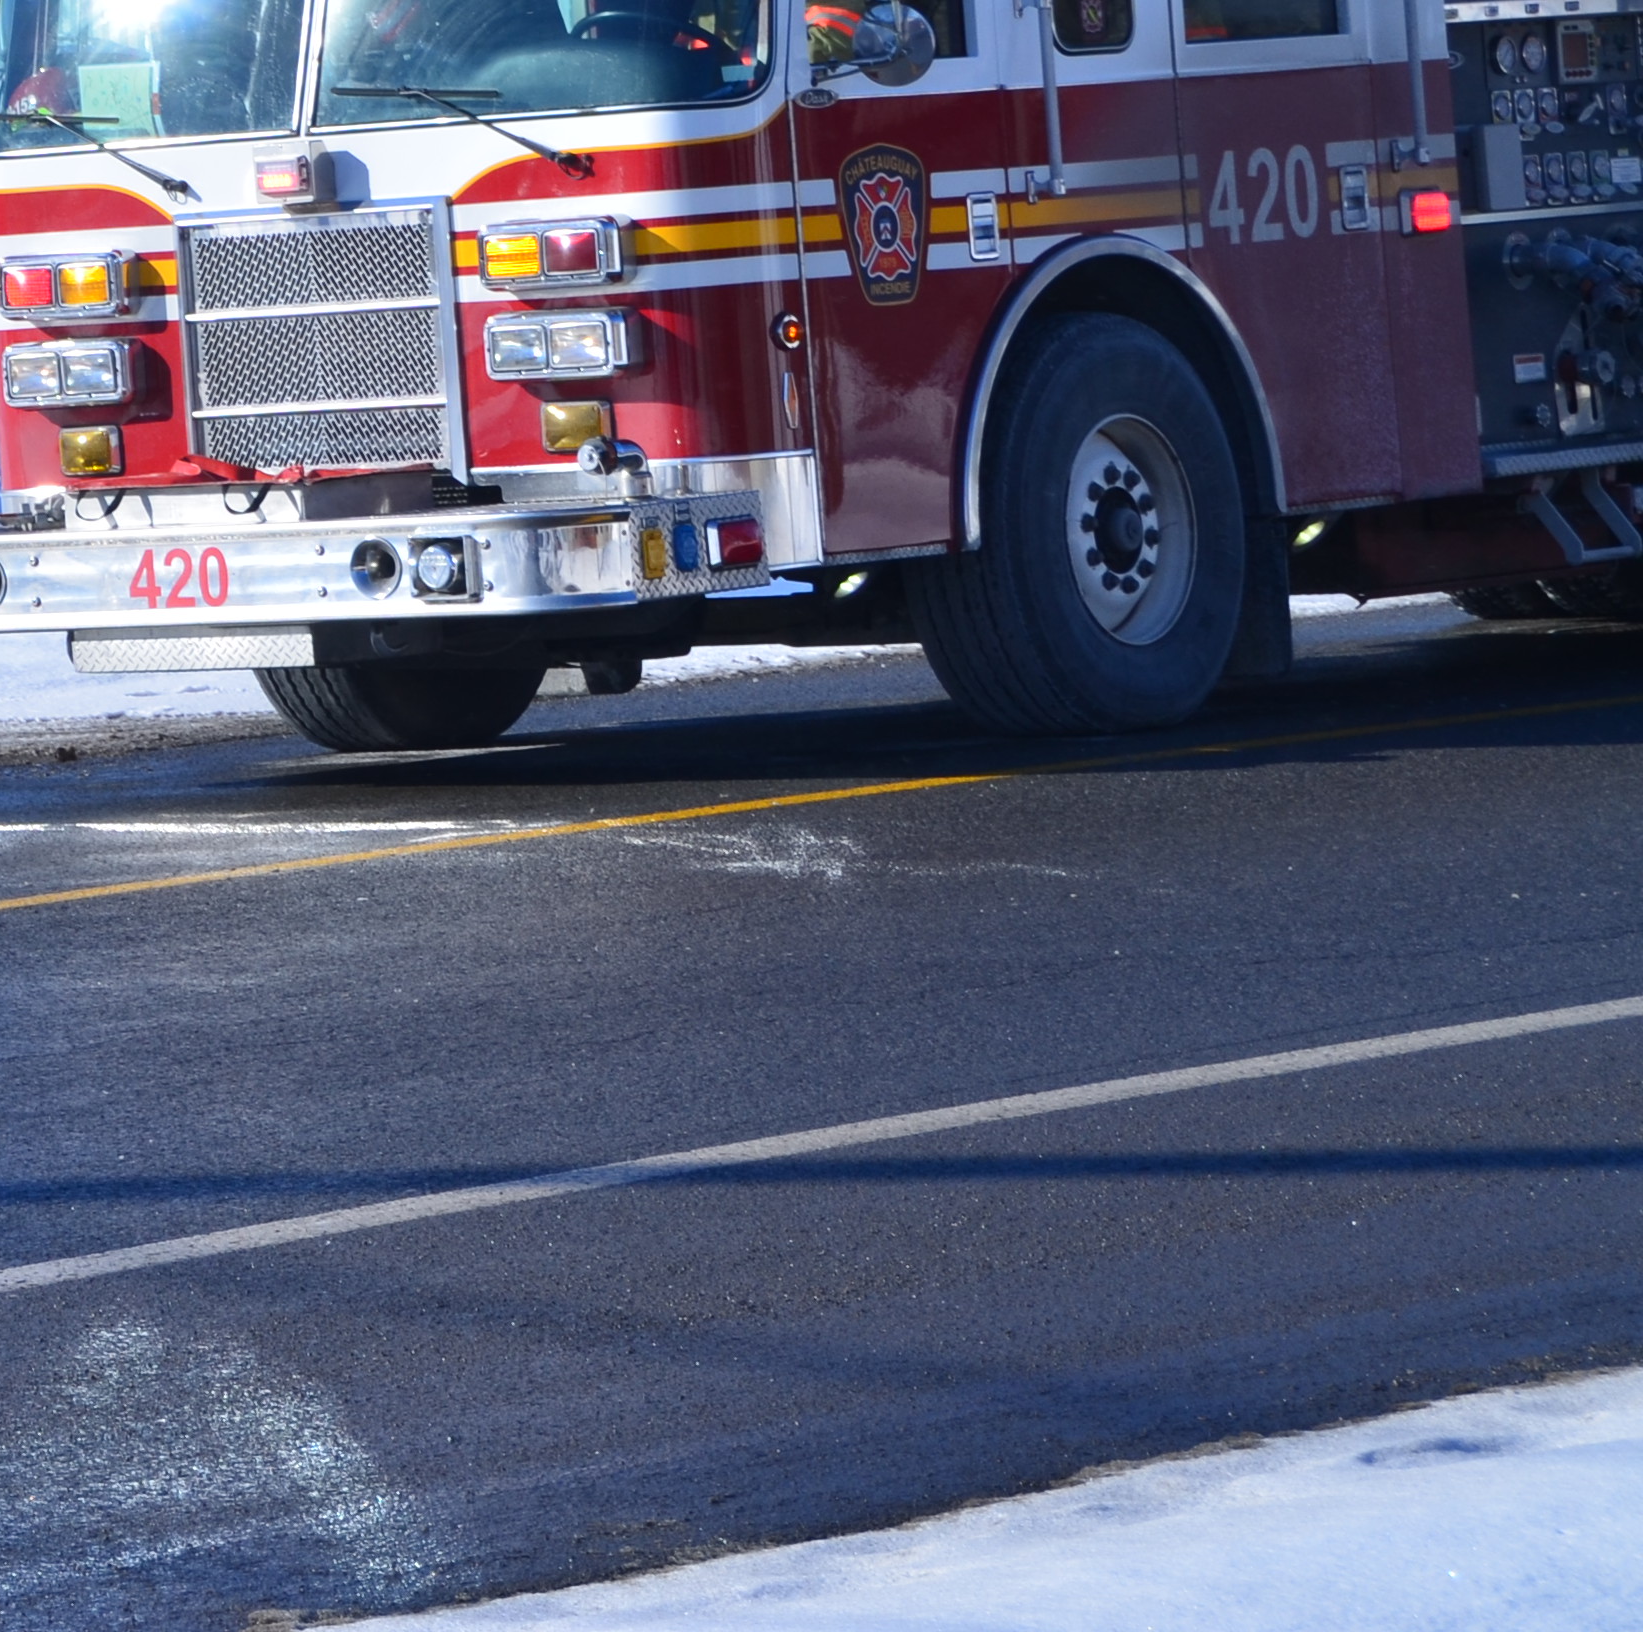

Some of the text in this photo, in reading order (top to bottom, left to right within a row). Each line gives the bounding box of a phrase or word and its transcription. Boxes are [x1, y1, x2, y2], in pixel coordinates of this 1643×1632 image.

[845, 153, 919, 185] CHÂTEAUGUAY
[1209, 144, 1319, 245] 420
[870, 281, 912, 296] INCENDIE
[129, 546, 229, 609] 420
